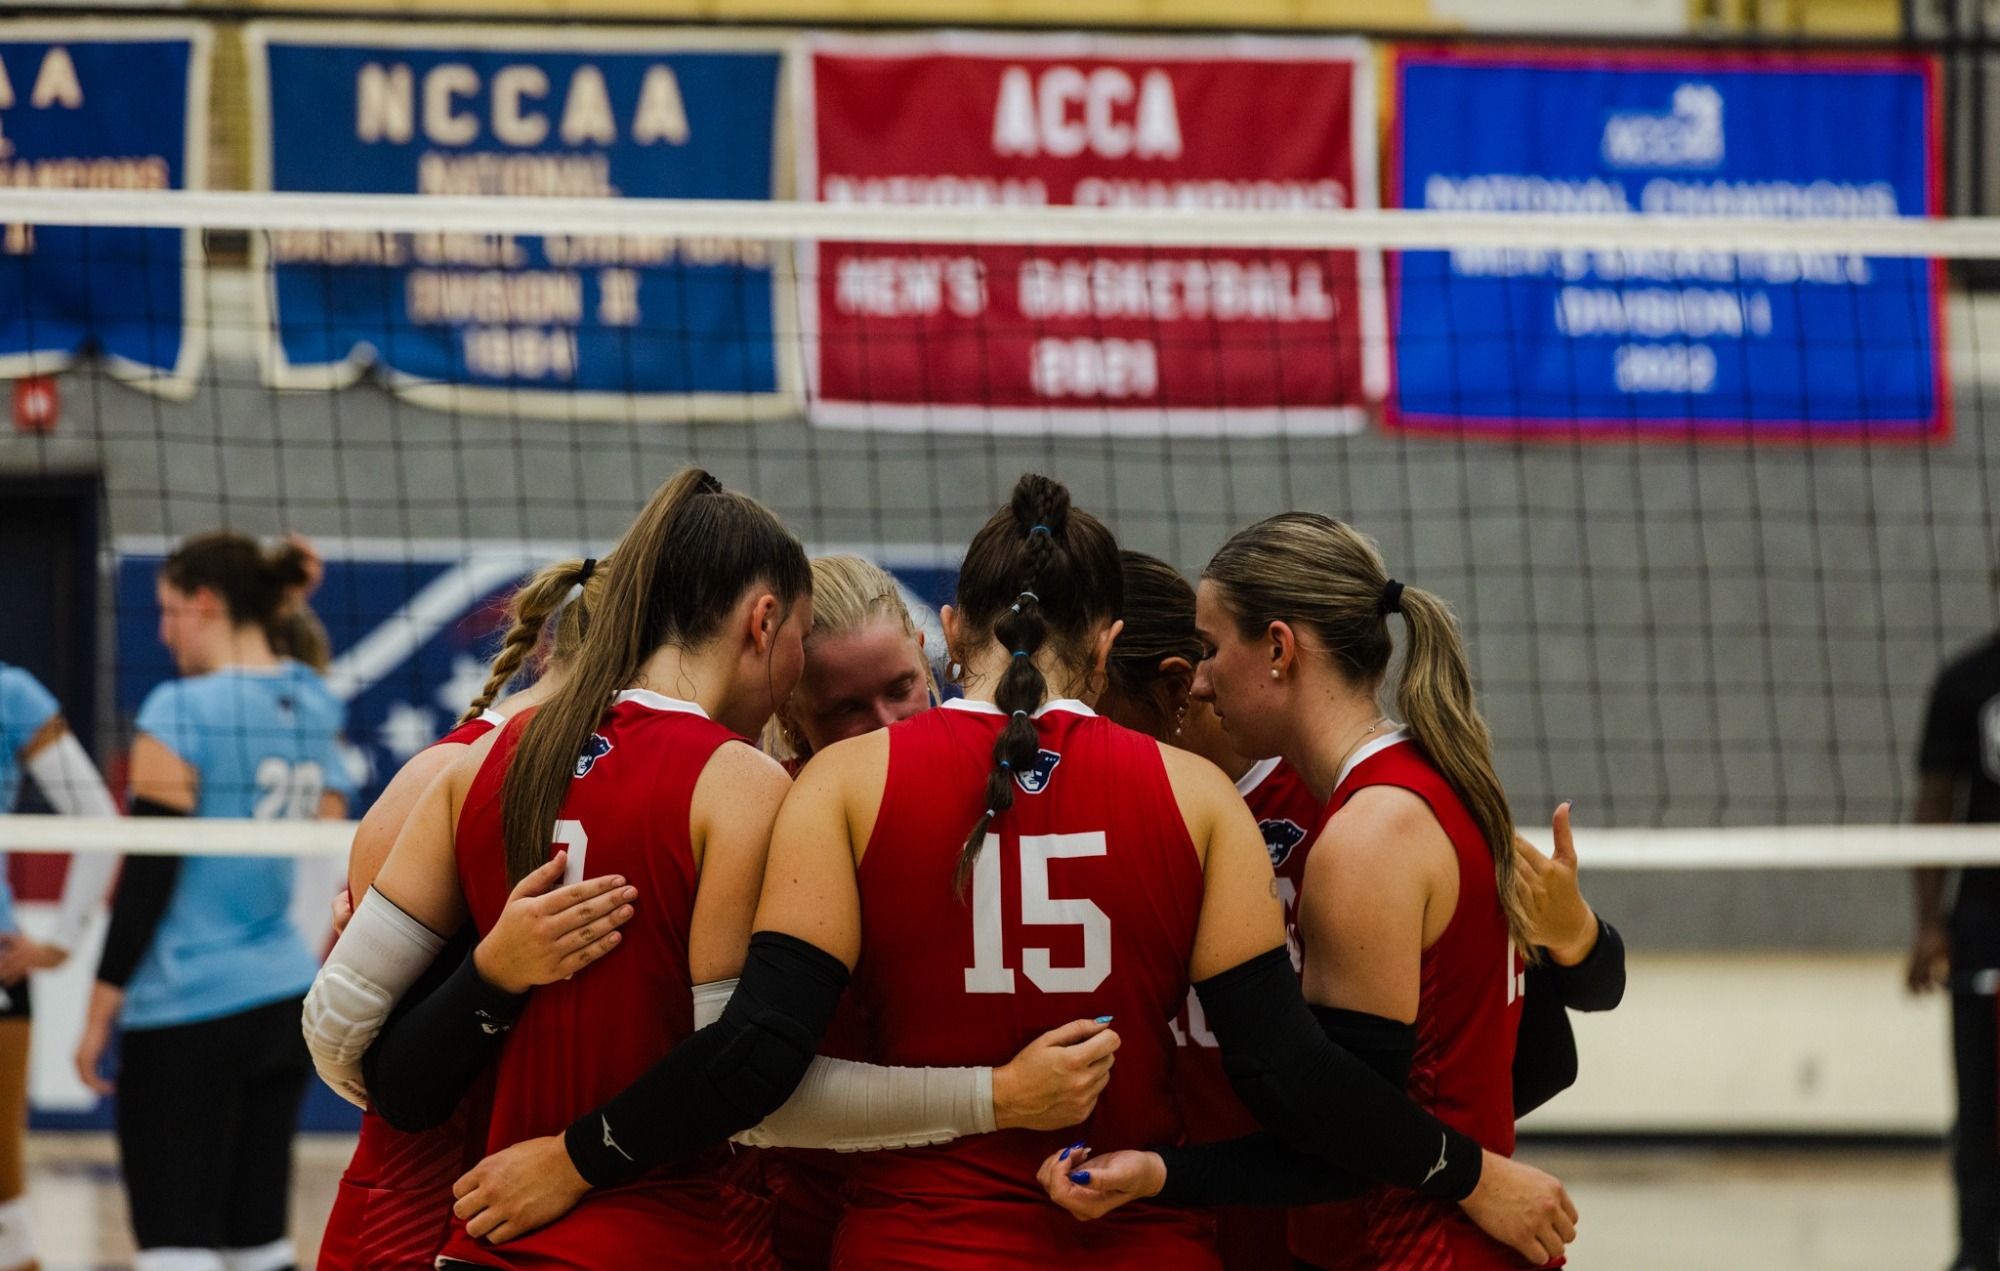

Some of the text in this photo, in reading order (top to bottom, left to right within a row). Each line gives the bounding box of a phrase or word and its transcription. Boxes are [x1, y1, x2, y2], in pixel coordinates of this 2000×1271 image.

[356, 62, 690, 146] NCCAA
[993, 66, 1183, 159] ACCA
[407, 270, 582, 325] DIVISION
[836, 256, 1335, 320] MEN'S BASKETBALL
[1557, 287, 1745, 336] DIVISION
[964, 831, 1112, 994] 15
